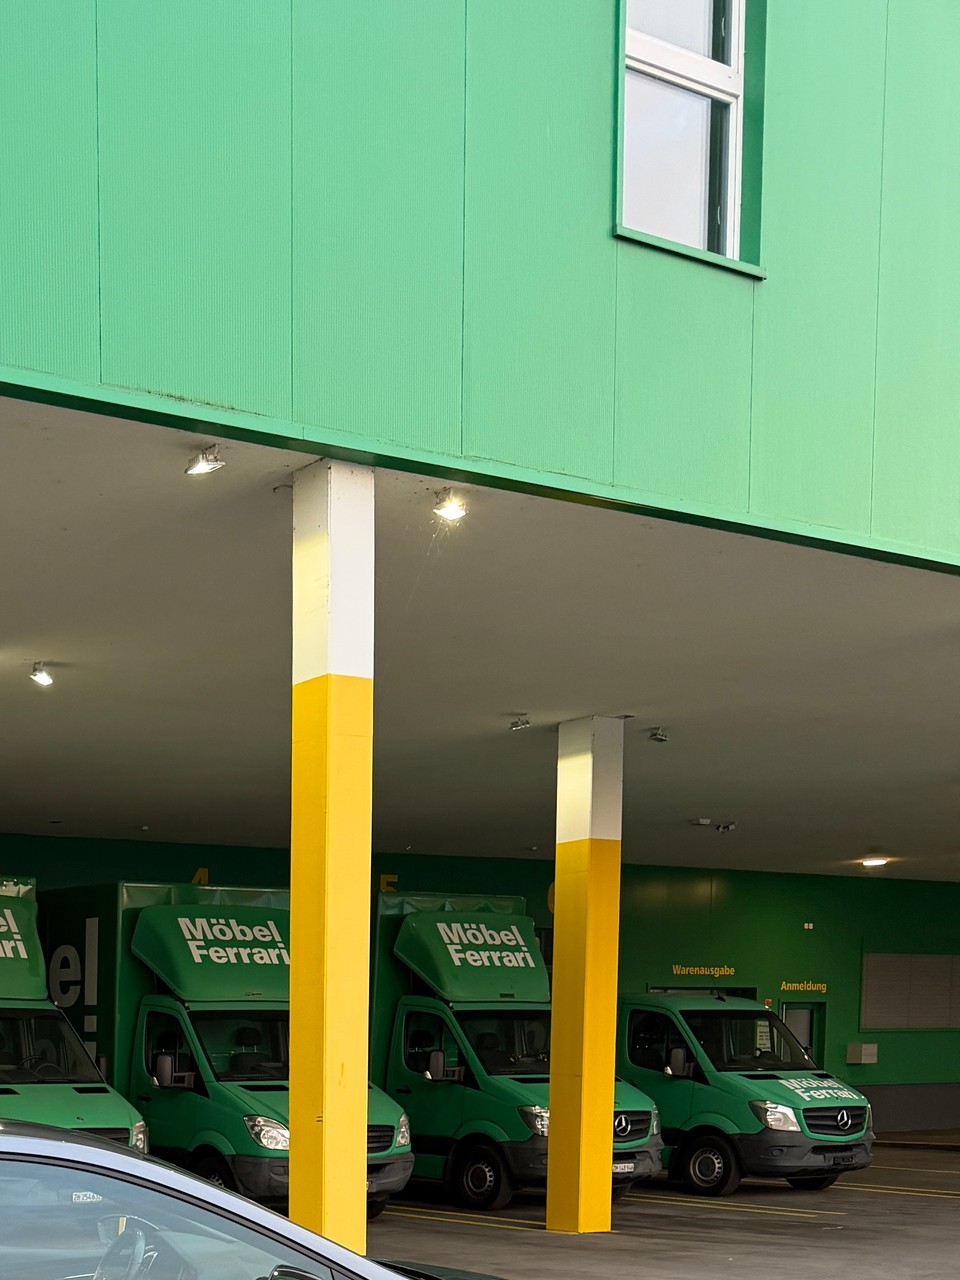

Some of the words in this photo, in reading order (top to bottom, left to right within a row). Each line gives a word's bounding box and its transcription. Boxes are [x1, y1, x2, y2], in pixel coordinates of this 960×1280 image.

[177, 917, 283, 943] Möbel
[436, 922, 526, 946] Möbel
[186, 940, 291, 966] Ferrari
[446, 944, 536, 968] Ferrari
[672, 965, 735, 978] Warenausgabe
[780, 981, 827, 993] Anmeldung
[779, 1078, 844, 1091] Möbel
[793, 1088, 860, 1102] Ferrari
